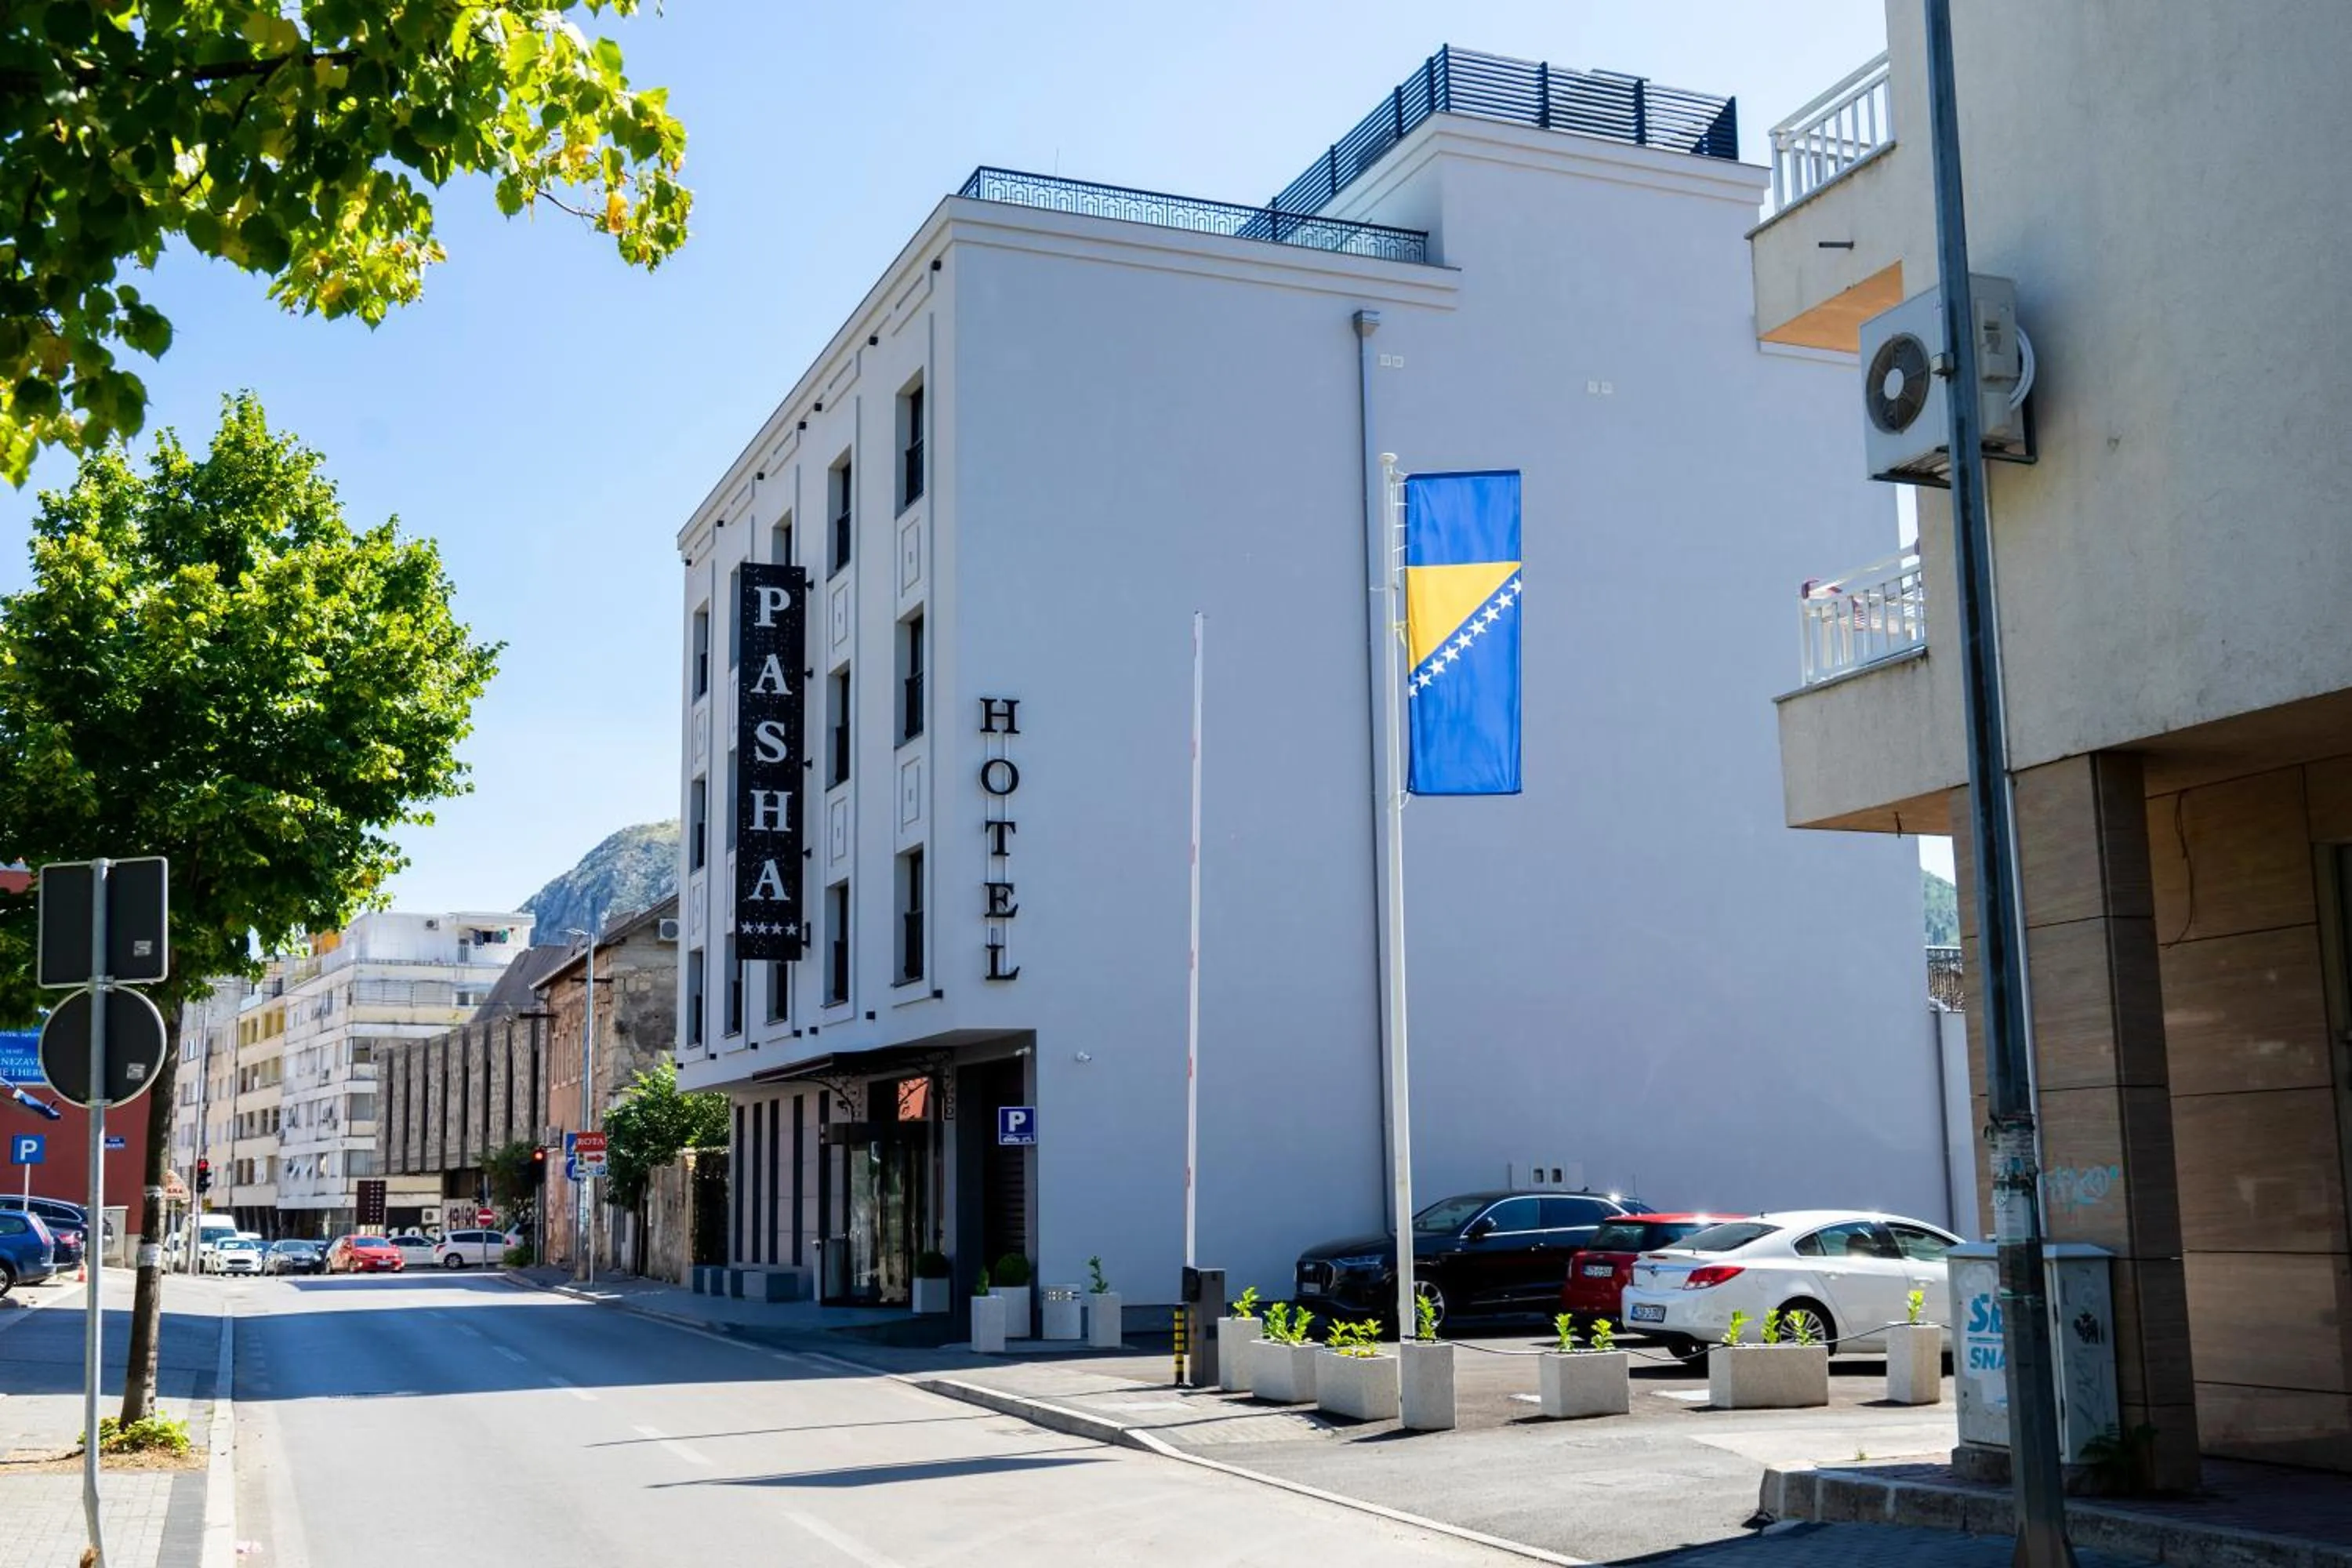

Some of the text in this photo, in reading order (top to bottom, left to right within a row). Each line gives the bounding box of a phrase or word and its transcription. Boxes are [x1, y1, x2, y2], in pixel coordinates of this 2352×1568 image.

[750, 586, 793, 901] PASHA
[978, 697, 1020, 981] HOTEL
[20, 1139, 38, 1161] P
[1008, 1111, 1026, 1132] P
